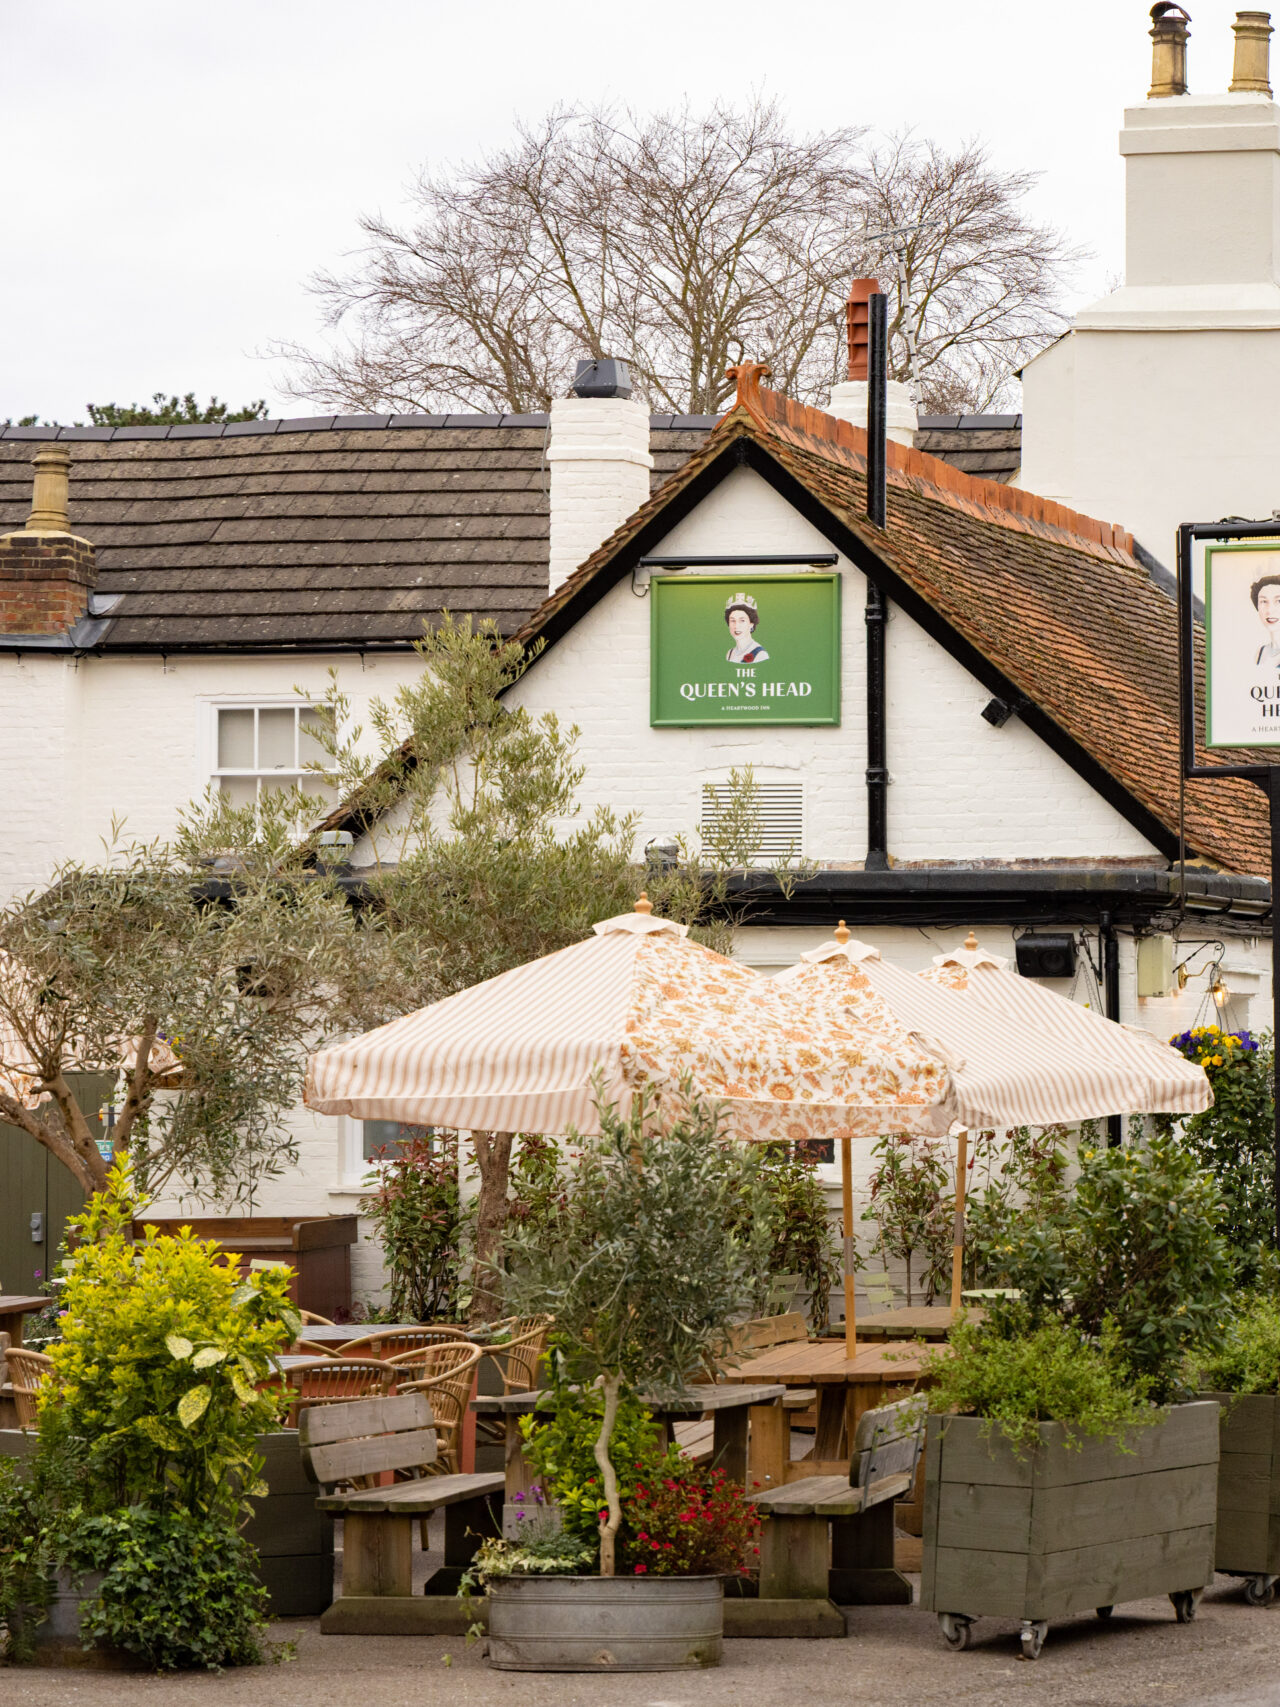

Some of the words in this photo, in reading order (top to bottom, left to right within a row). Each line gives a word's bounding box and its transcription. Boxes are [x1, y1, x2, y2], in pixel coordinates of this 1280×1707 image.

[735, 668, 757, 678] THE
[680, 681, 756, 701] QUEEN'S
[762, 682, 812, 697] HEAD
